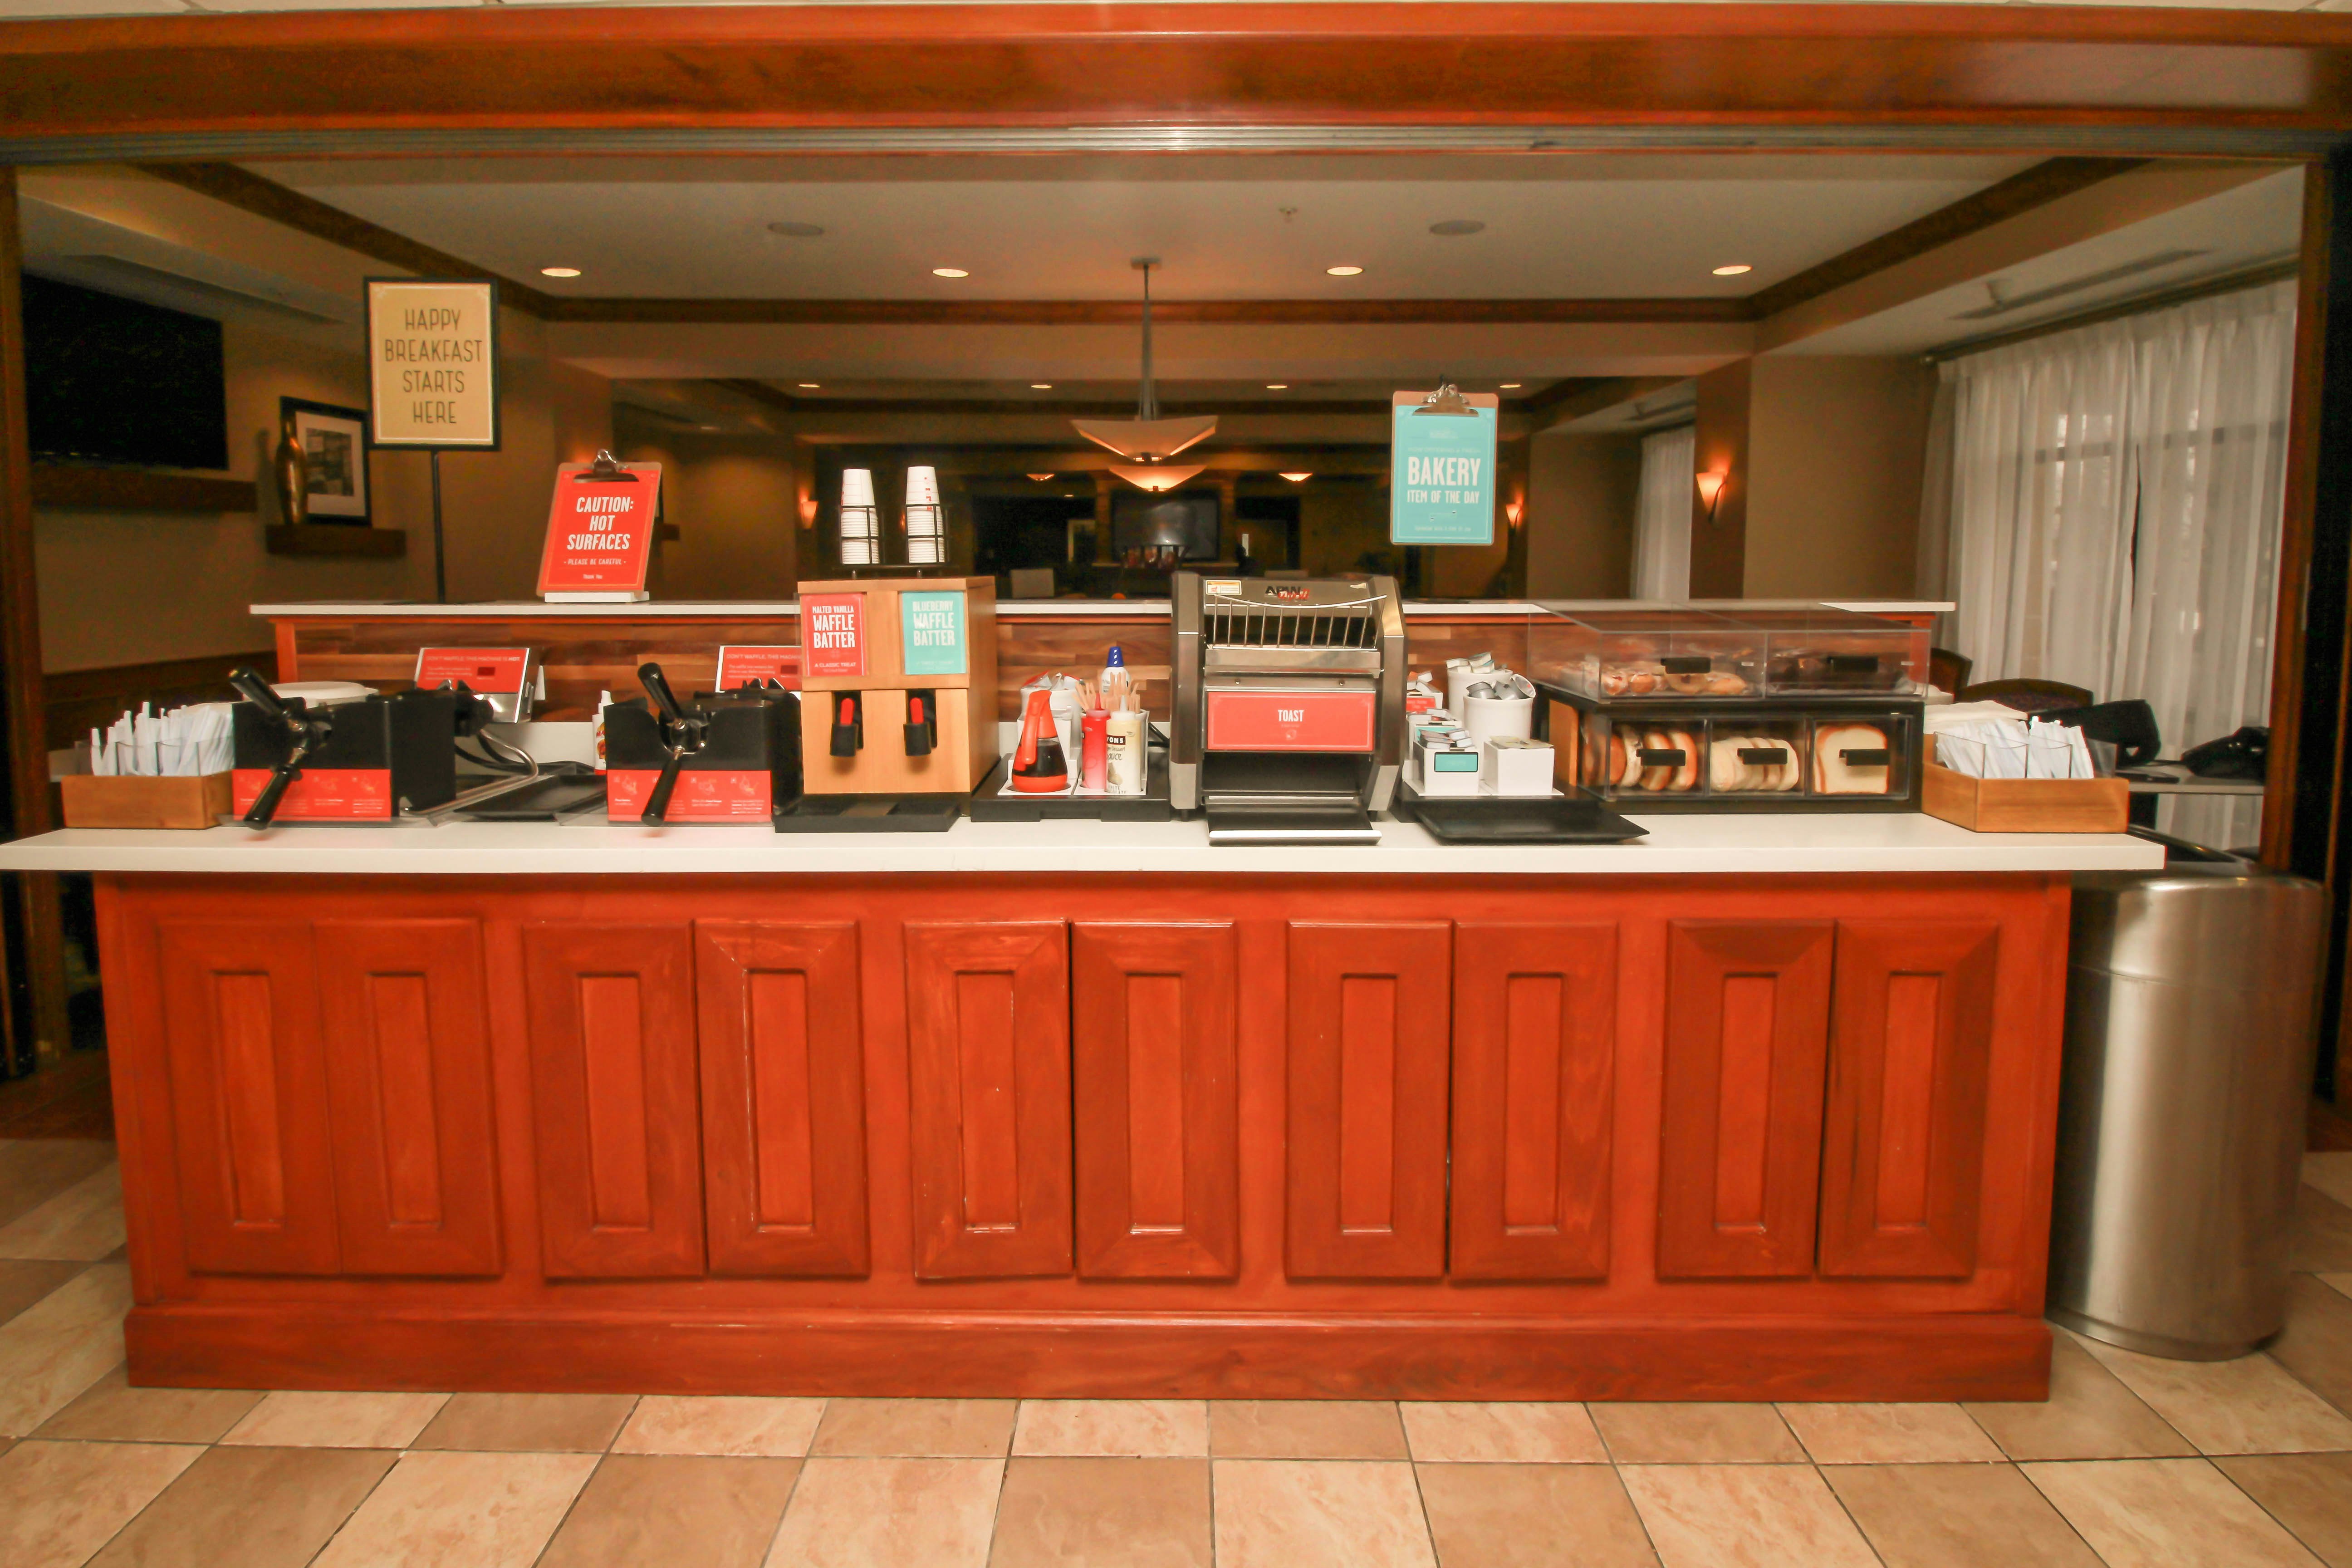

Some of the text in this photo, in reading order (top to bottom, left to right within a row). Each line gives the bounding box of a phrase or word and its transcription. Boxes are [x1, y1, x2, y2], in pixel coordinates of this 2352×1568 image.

[405, 309, 461, 331] HAPPY
[385, 339, 482, 362] BREAKFAST
[403, 370, 465, 392] STARTS
[413, 401, 457, 423] HERE
[1408, 456, 1481, 486] BAKERY
[576, 496, 634, 512] CAUTION:
[1407, 490, 1480, 504] ITEM OF THE DAY
[589, 515, 615, 531] HOT
[567, 534, 630, 550] SURFACES
[912, 600, 953, 612] BLUEBERRY
[813, 614, 855, 631] WAFFLE
[913, 612, 955, 629] WAFFLE
[813, 632, 856, 648] BATTER
[913, 629, 955, 646] BATTER
[1277, 709, 1304, 722] TOAST
